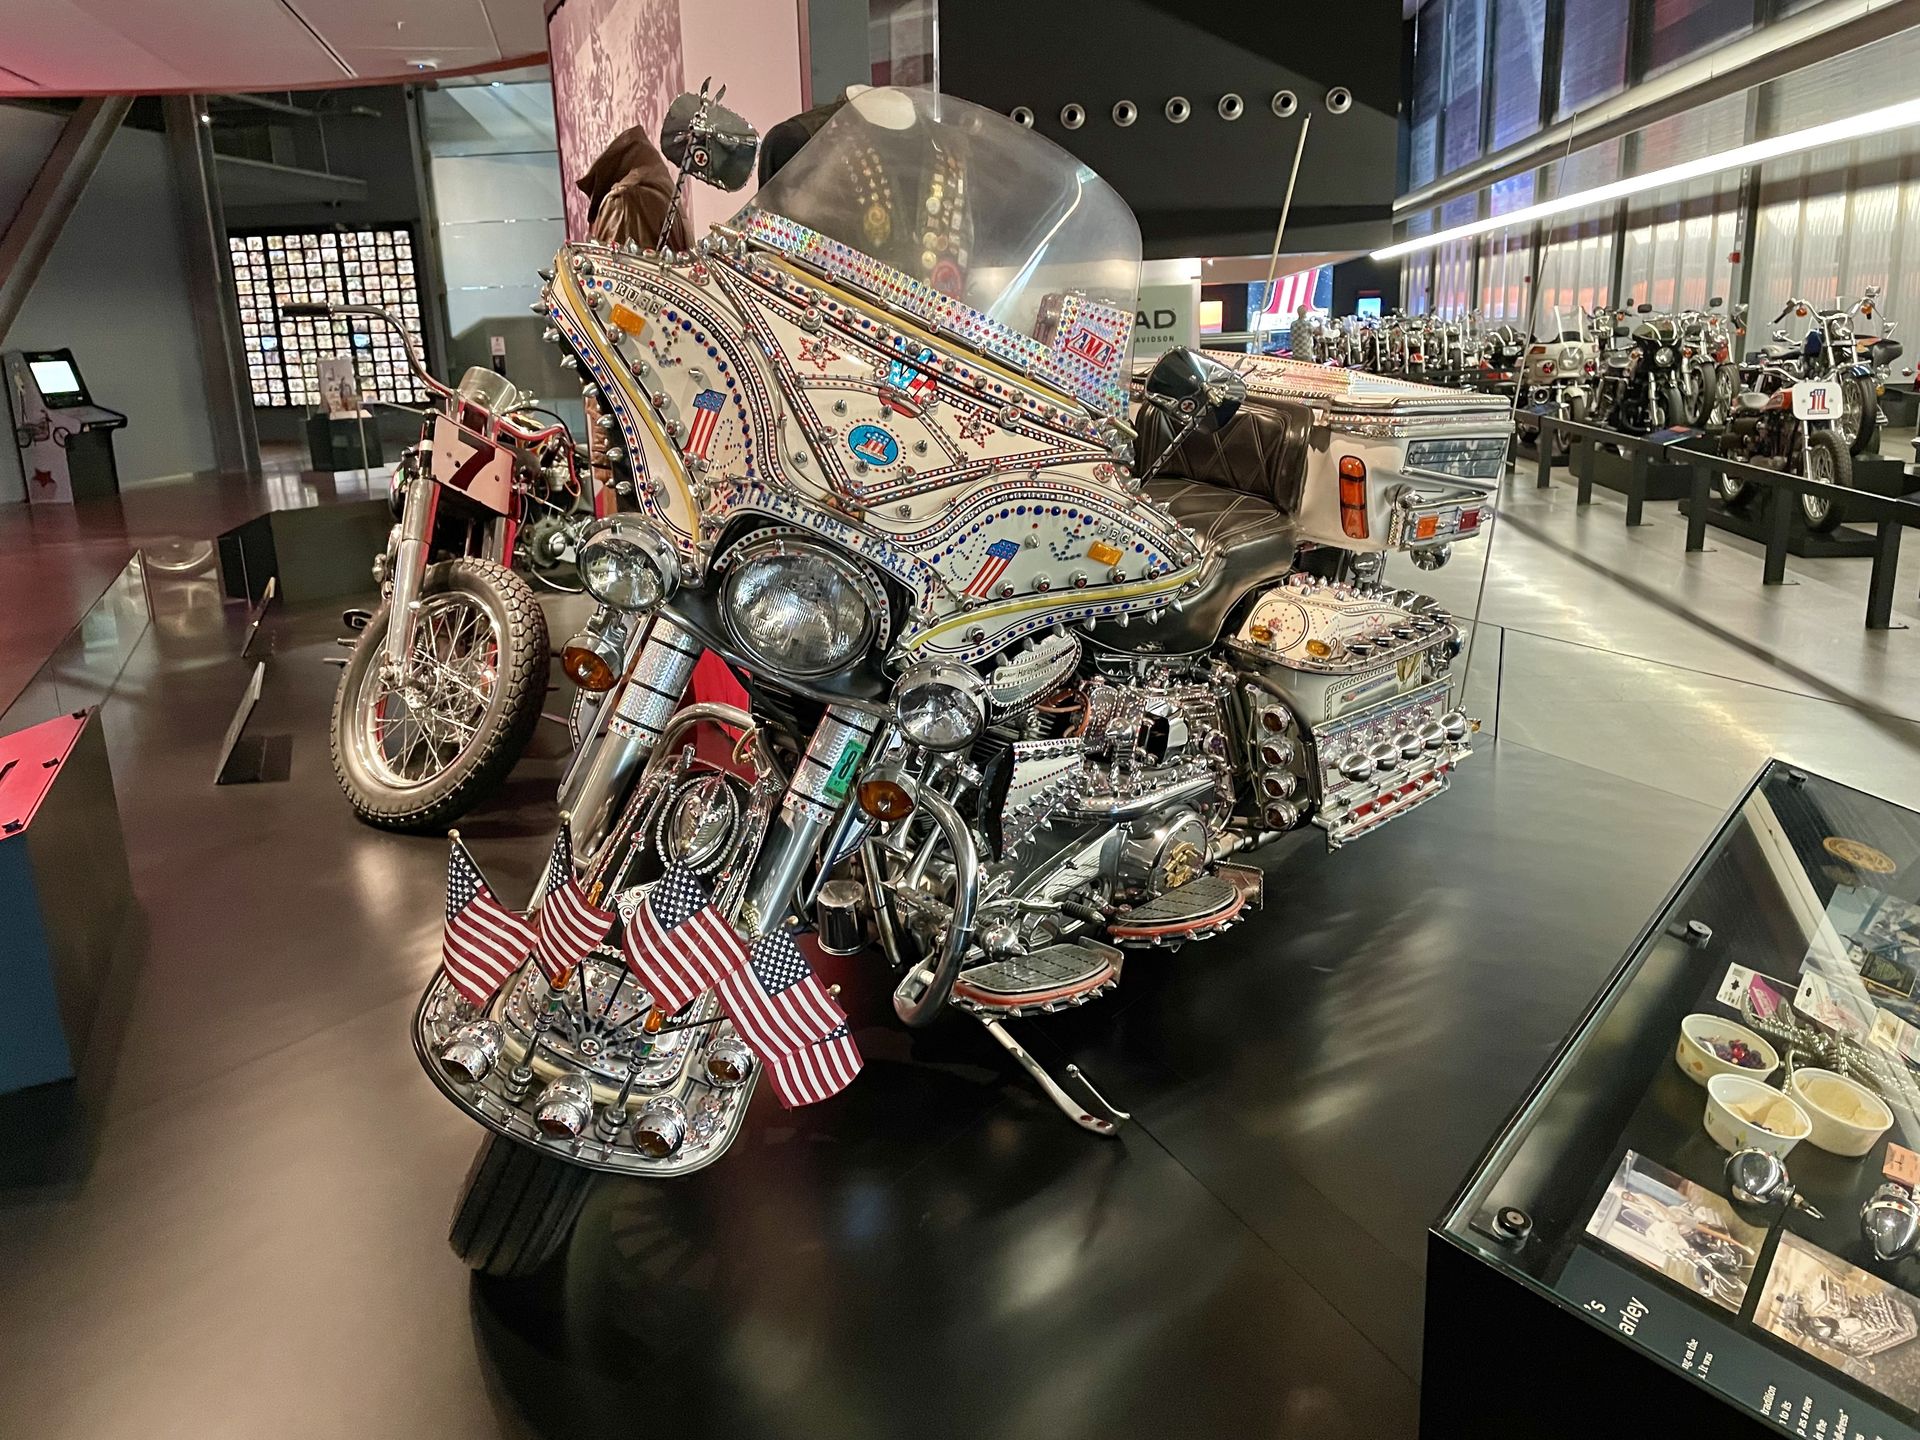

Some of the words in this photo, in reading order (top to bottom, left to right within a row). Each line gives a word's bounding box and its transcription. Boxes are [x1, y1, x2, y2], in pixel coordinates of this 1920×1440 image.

[1071, 331, 1111, 363] AMA
[449, 428, 496, 491] 7
[1097, 523, 1130, 544] PEG
